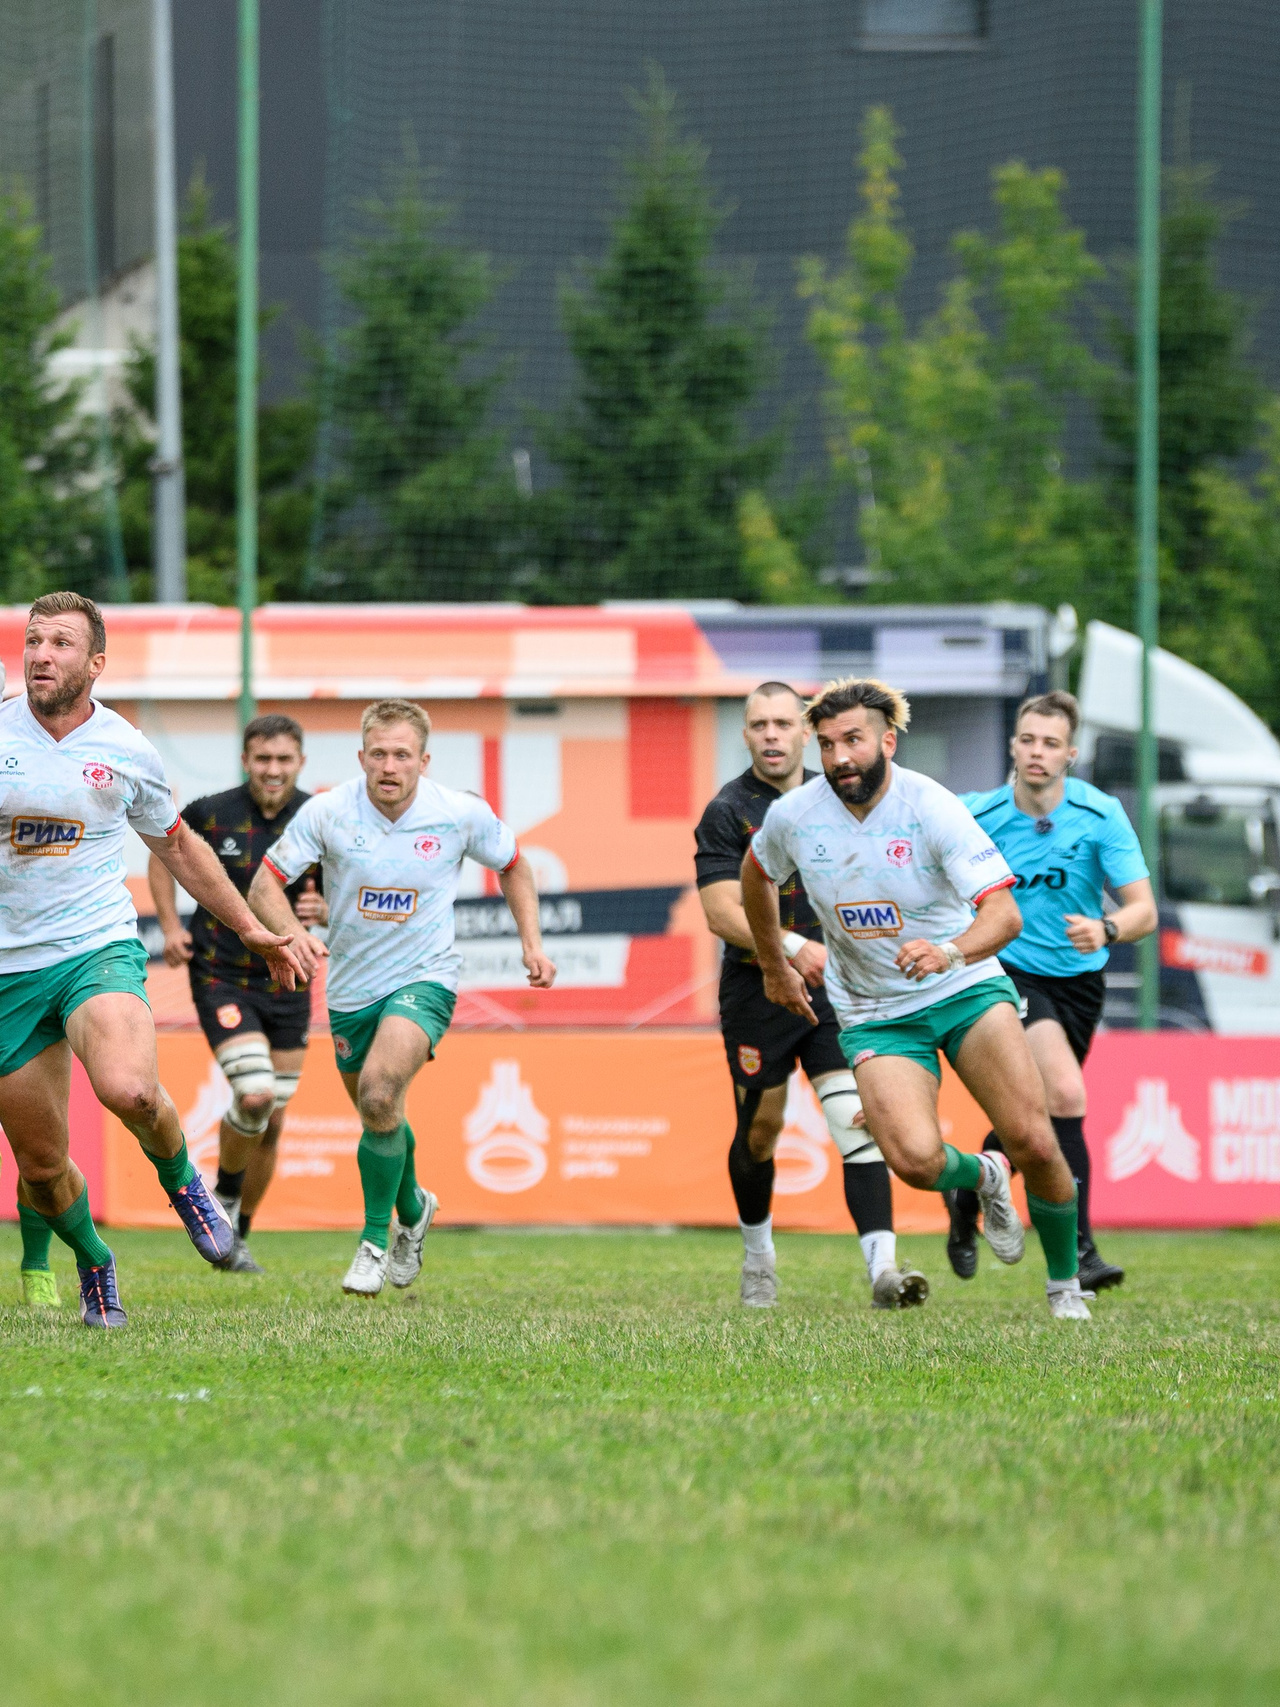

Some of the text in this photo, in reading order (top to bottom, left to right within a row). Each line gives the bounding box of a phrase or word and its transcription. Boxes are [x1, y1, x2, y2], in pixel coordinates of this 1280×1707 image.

[17, 822, 77, 843] РИМ
[363, 891, 413, 911] РИМ
[841, 906, 896, 927] РИМ
[1210, 1078, 1280, 1127] МО
